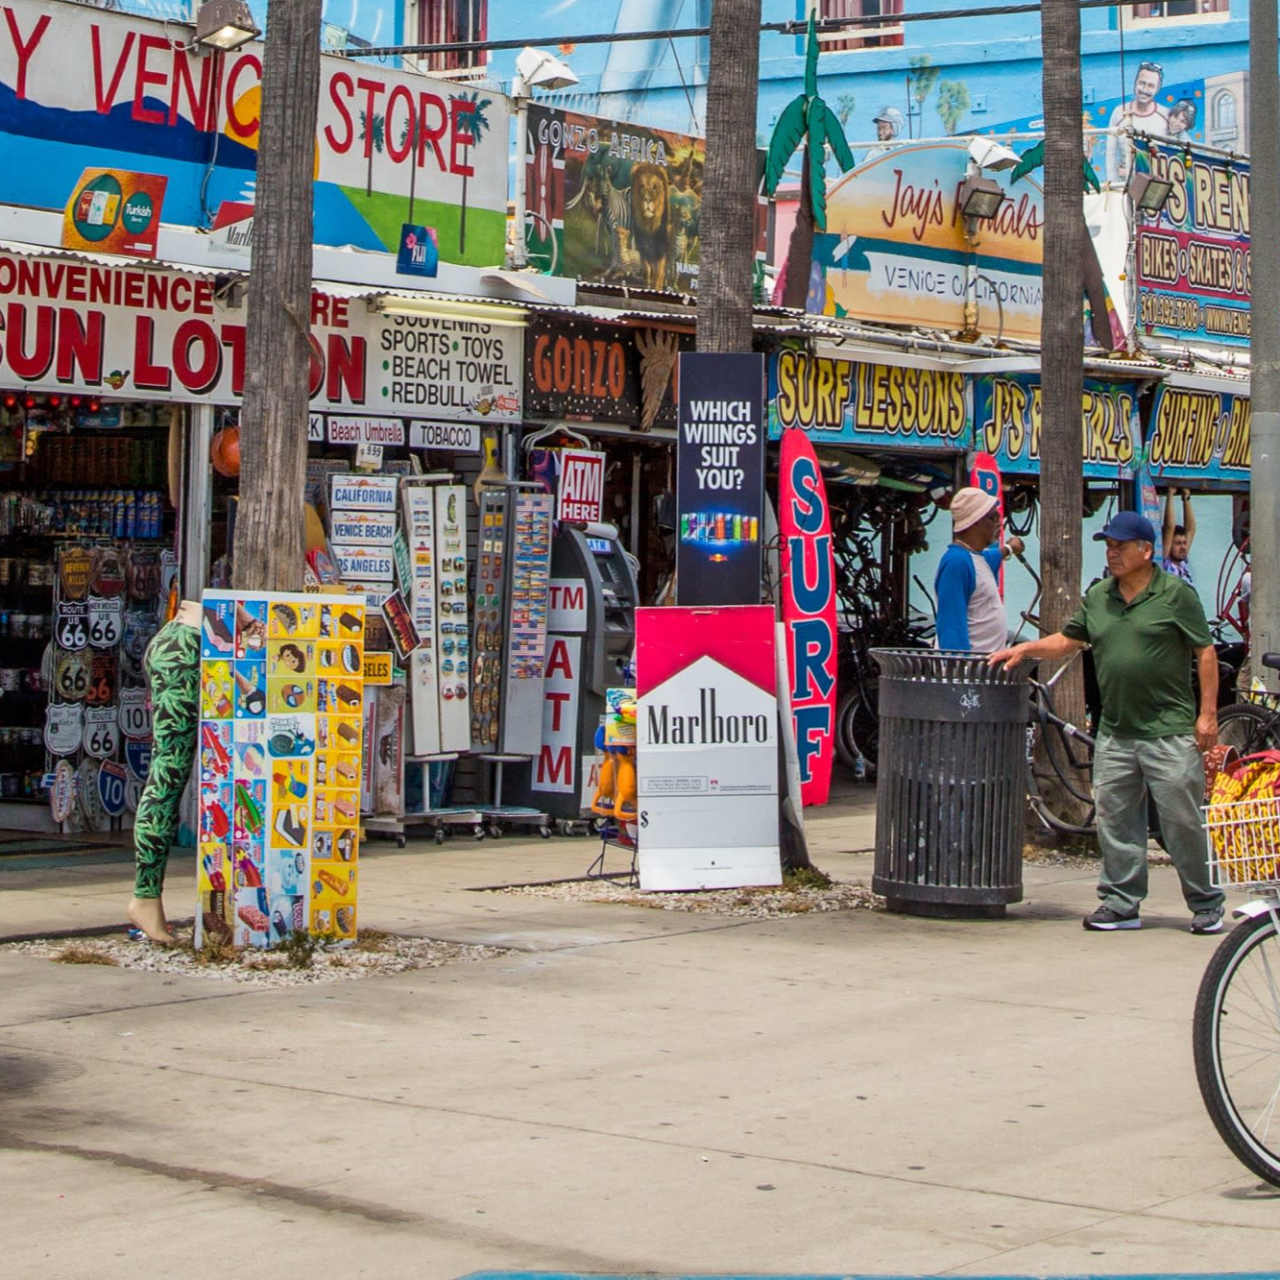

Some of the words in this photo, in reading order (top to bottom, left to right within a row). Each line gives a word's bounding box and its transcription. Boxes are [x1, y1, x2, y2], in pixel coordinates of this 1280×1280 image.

[91, 23, 263, 138] VENIC
[324, 71, 477, 178] STORE
[537, 118, 600, 154] GONZO
[882, 168, 944, 242] Jay's
[1142, 235, 1178, 281] BIKES
[1188, 243, 1233, 292] SKATES
[1235, 252, 1244, 292] &
[885, 265, 946, 295] VENICE
[380, 328, 450, 356] SPORTS
[461, 336, 504, 361] TOYS
[392, 355, 450, 381] BEACH
[456, 361, 513, 386] TOWEL
[534, 333, 626, 399] GONZO
[392, 381, 470, 408] REDBULL
[778, 350, 851, 430] SURF
[853, 361, 966, 438] LESSONS
[690, 400, 751, 422] WHICH
[331, 420, 361, 441] Beach
[364, 423, 403, 443] Umbrella
[421, 424, 472, 448] TOBACCO
[684, 423, 756, 445] WIIINGS
[1151, 387, 1221, 468] SURFING
[701, 446, 740, 467] SUIT
[562, 460, 601, 502] ATM
[696, 469, 744, 490] YOU?
[334, 487, 393, 504] CALIFORNIA
[562, 502, 599, 521] HERE
[334, 522, 363, 538] VENICE
[365, 523, 393, 539] BEACH
[350, 558, 391, 573] ANGELES
[90, 619, 116, 642] 66
[790, 456, 835, 784] SURF
[61, 622, 87, 647] 66
[61, 665, 87, 692] 66
[126, 707, 151, 729] 101
[536, 639, 574, 787] ATM
[648, 687, 768, 745] Marlboro
[90, 730, 114, 753] 66
[104, 776, 121, 805] 10
